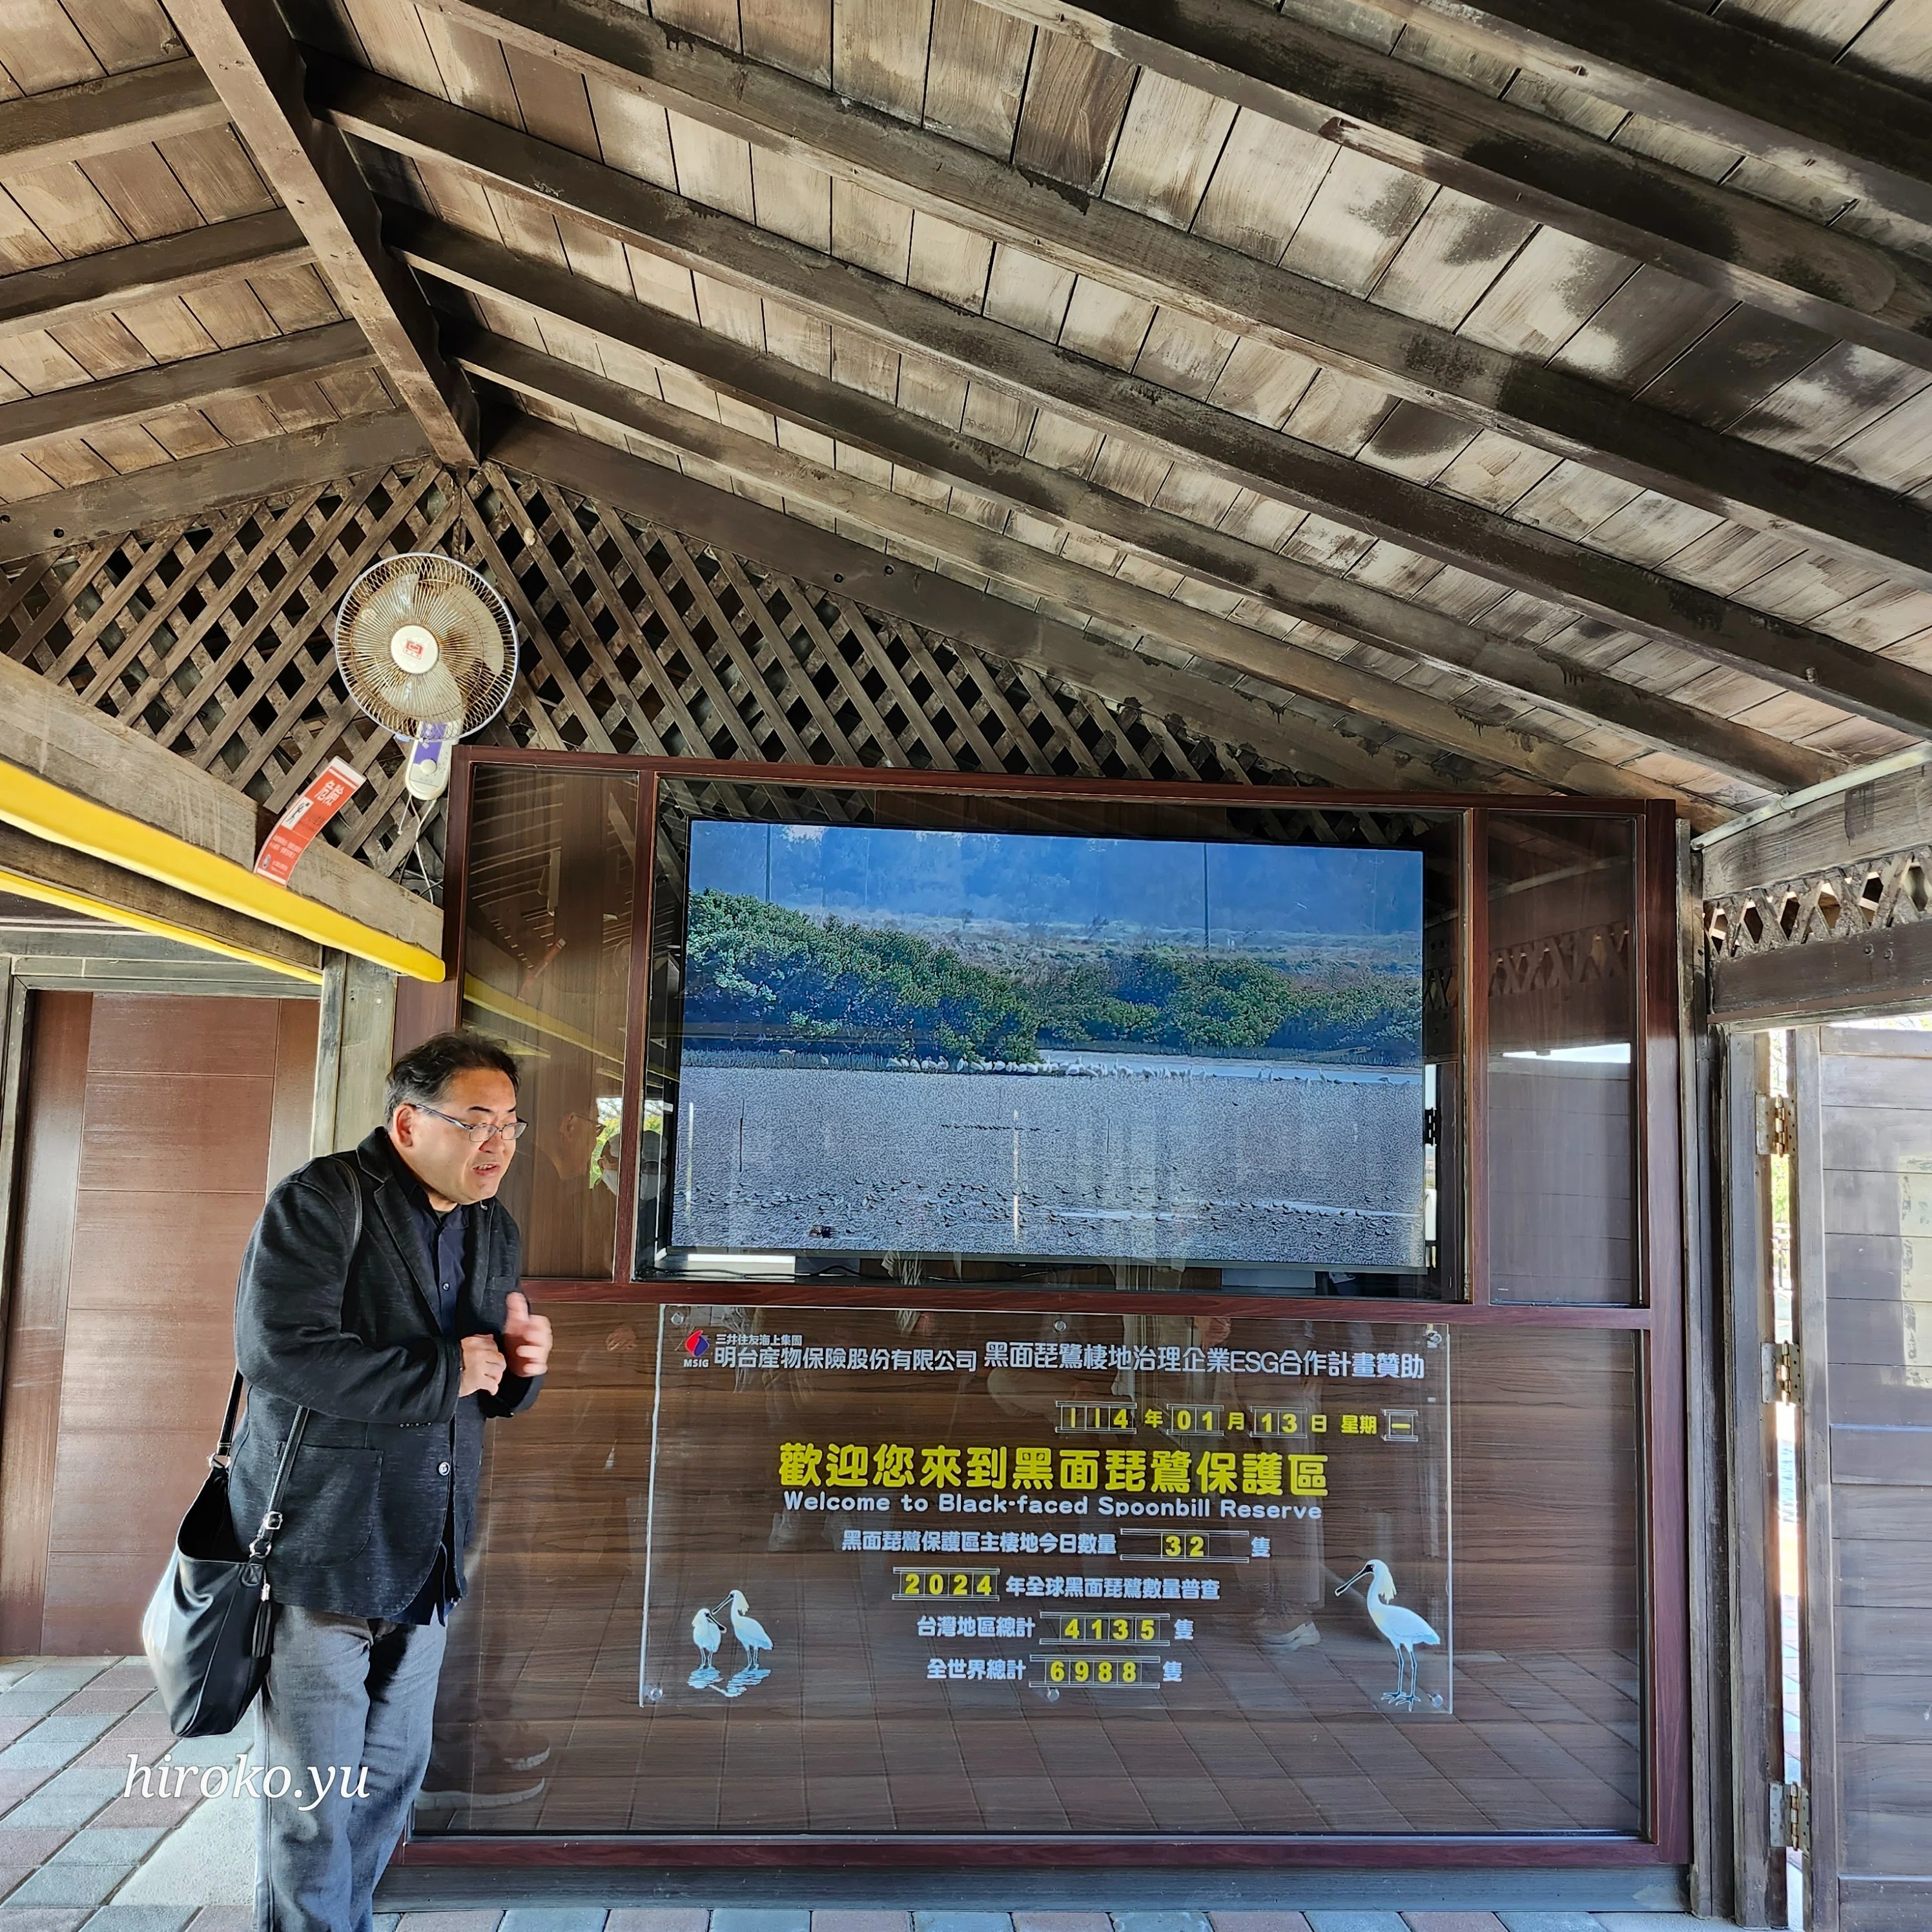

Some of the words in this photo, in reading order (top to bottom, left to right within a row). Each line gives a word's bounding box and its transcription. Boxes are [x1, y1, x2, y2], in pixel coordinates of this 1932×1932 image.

[684, 1359, 709, 1368] MSIG
[1144, 1409, 1164, 1428] 年
[1177, 1410, 1213, 1431] 01
[1228, 1412, 1244, 1431] 月
[1262, 1412, 1297, 1434] 13
[1311, 1414, 1327, 1433] 日
[1341, 1414, 1377, 1434] 星期
[779, 1443, 1328, 1496] 歡迎您來到黑面琵鷺保護區
[784, 1490, 890, 1511] Welcome
[901, 1494, 929, 1512] to
[938, 1493, 1088, 1514] Black-faced
[1098, 1496, 1210, 1517] Spoonbill
[1220, 1499, 1322, 1519] Reserve
[841, 1529, 1117, 1555] 黑面琵鷺保護區主棲地今日數量
[1164, 1535, 1204, 1557] 32
[1251, 1536, 1271, 1557] 隻
[905, 1574, 992, 1596] 2024
[1005, 1575, 1220, 1600] 年全球黑面琵鷺數量普查
[917, 1616, 1035, 1638] 台灣地區總計
[1064, 1618, 1155, 1640] 4135
[1173, 1618, 1194, 1640] 隻
[927, 1658, 1027, 1681] 全世界總計
[1049, 1660, 1137, 1683] 6988
[1162, 1660, 1182, 1683] 隻
